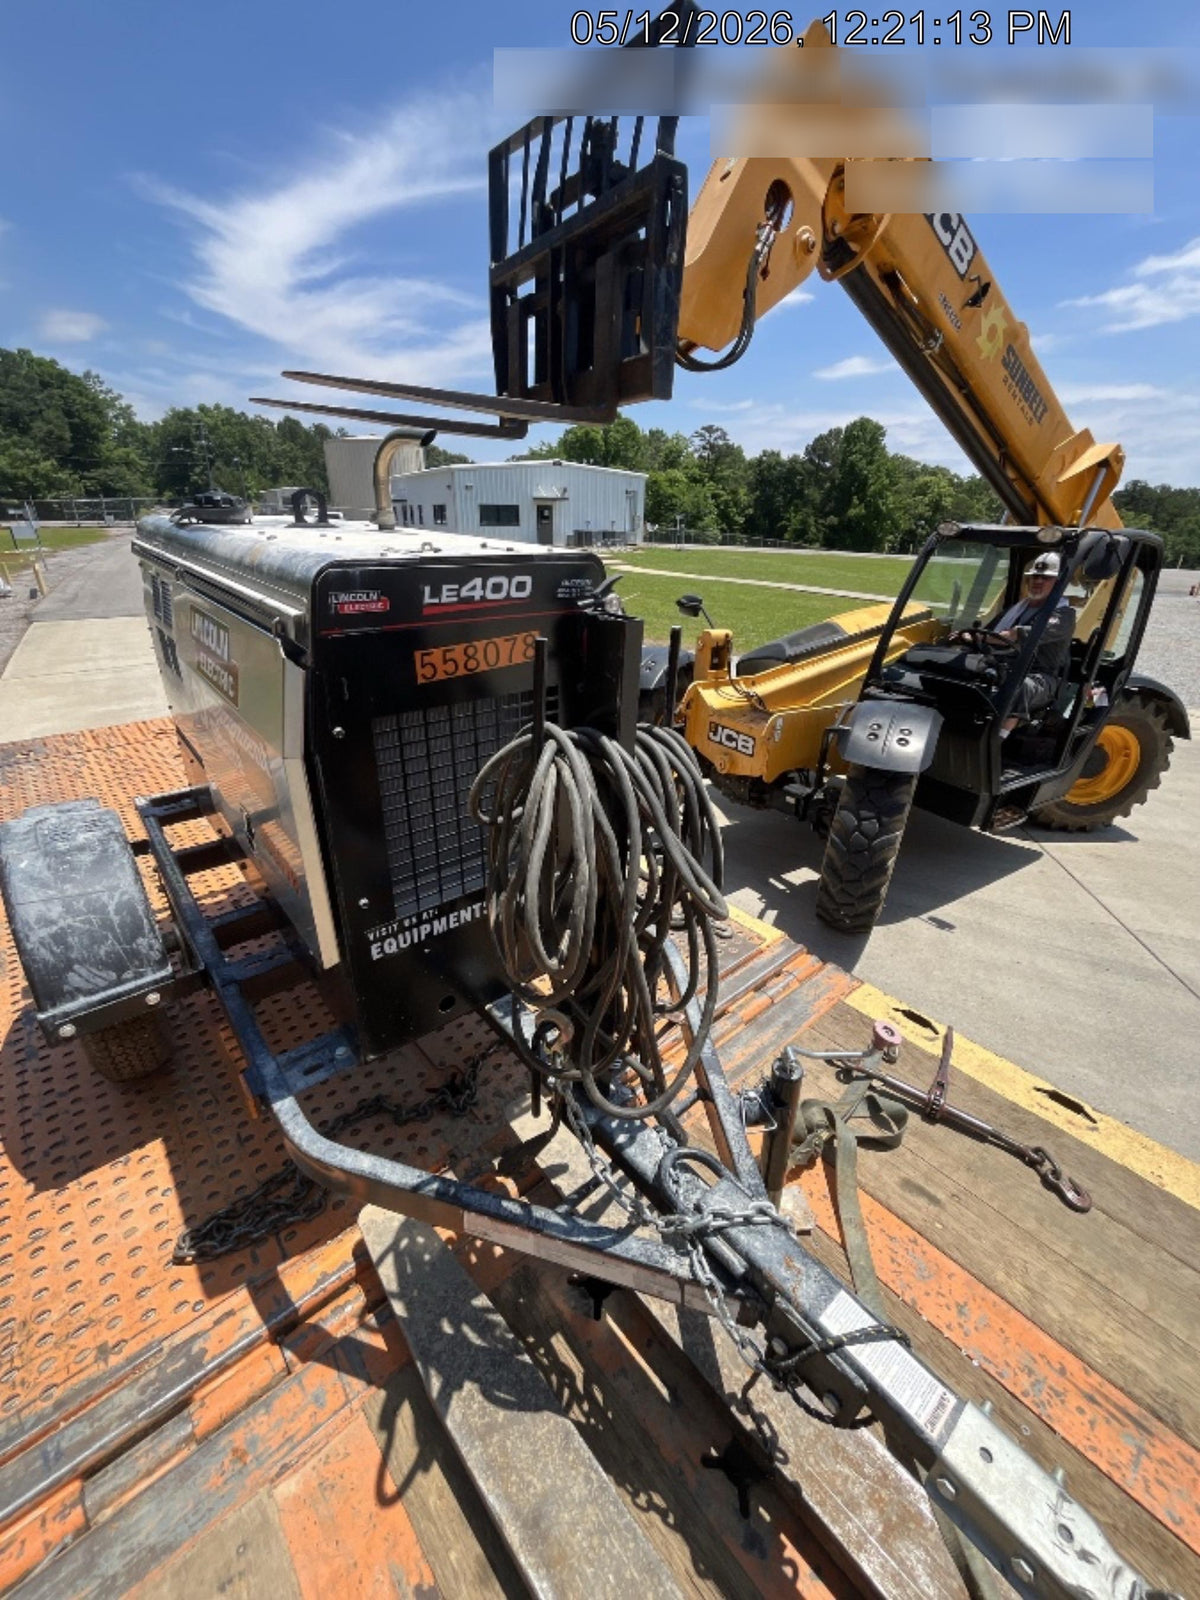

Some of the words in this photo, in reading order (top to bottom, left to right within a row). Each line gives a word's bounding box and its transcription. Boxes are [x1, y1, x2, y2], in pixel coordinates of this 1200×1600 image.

[930, 213, 974, 276] CB
[1001, 343, 1049, 424] SUNBELT
[331, 591, 378, 604] LINCOLN
[423, 575, 532, 604] LE400
[419, 633, 537, 680] 558078
[709, 723, 755, 756] JCB
[367, 922, 399, 941] VISIT
